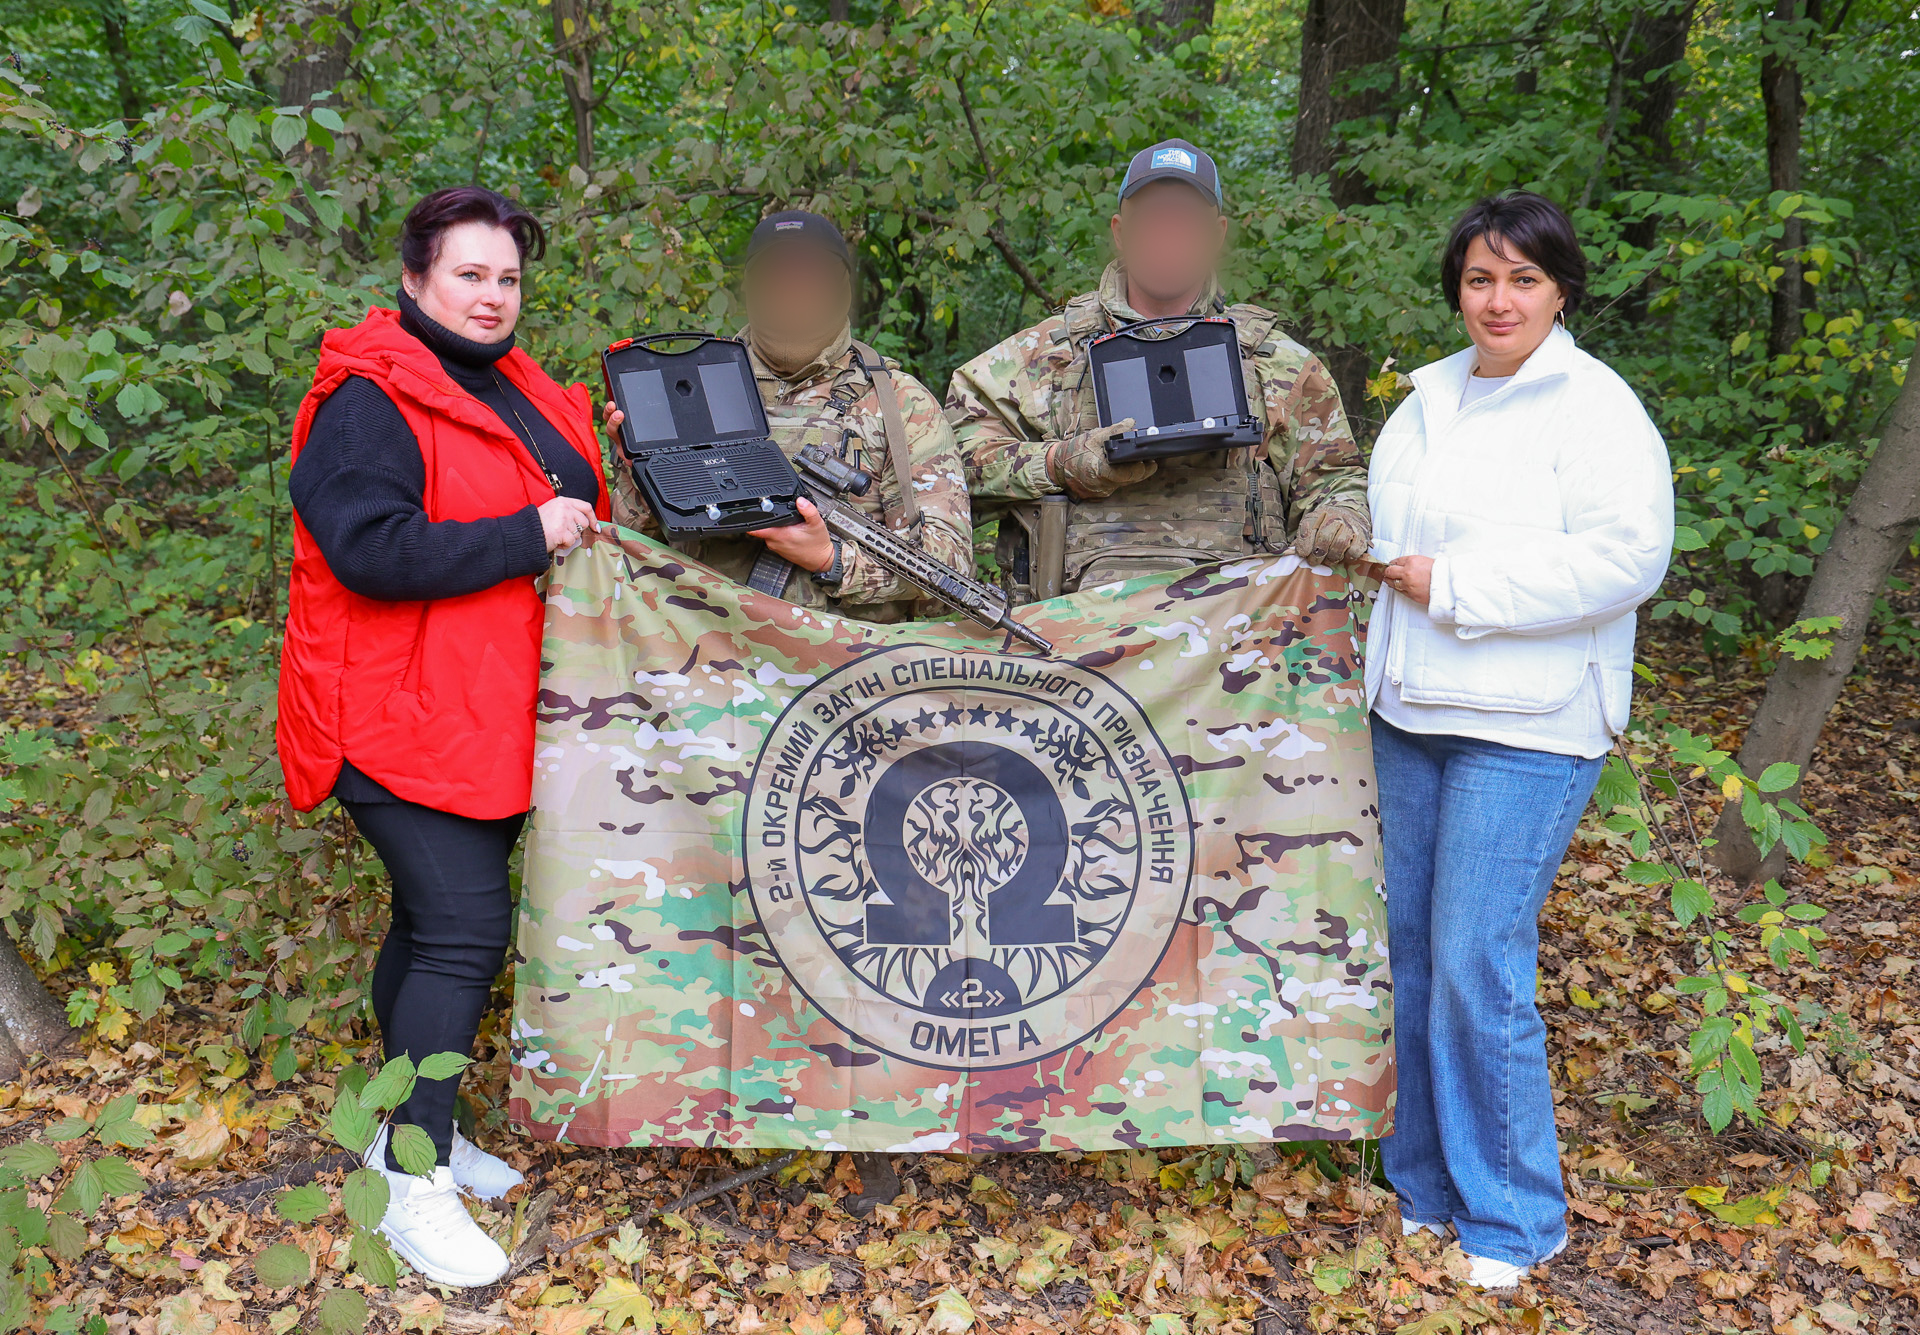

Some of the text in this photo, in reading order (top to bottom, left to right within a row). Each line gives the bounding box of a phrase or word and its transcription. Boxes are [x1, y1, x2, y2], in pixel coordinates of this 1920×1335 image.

[762, 720, 819, 847] ОКРЕМИЙ
[813, 672, 886, 724] ЗАГІН
[891, 657, 1095, 709] СПЕЦІАЛЬНОГО
[1092, 702, 1175, 884] ПРИЗНАЧЕННЯ
[910, 1019, 1041, 1057] ОМЕГА
